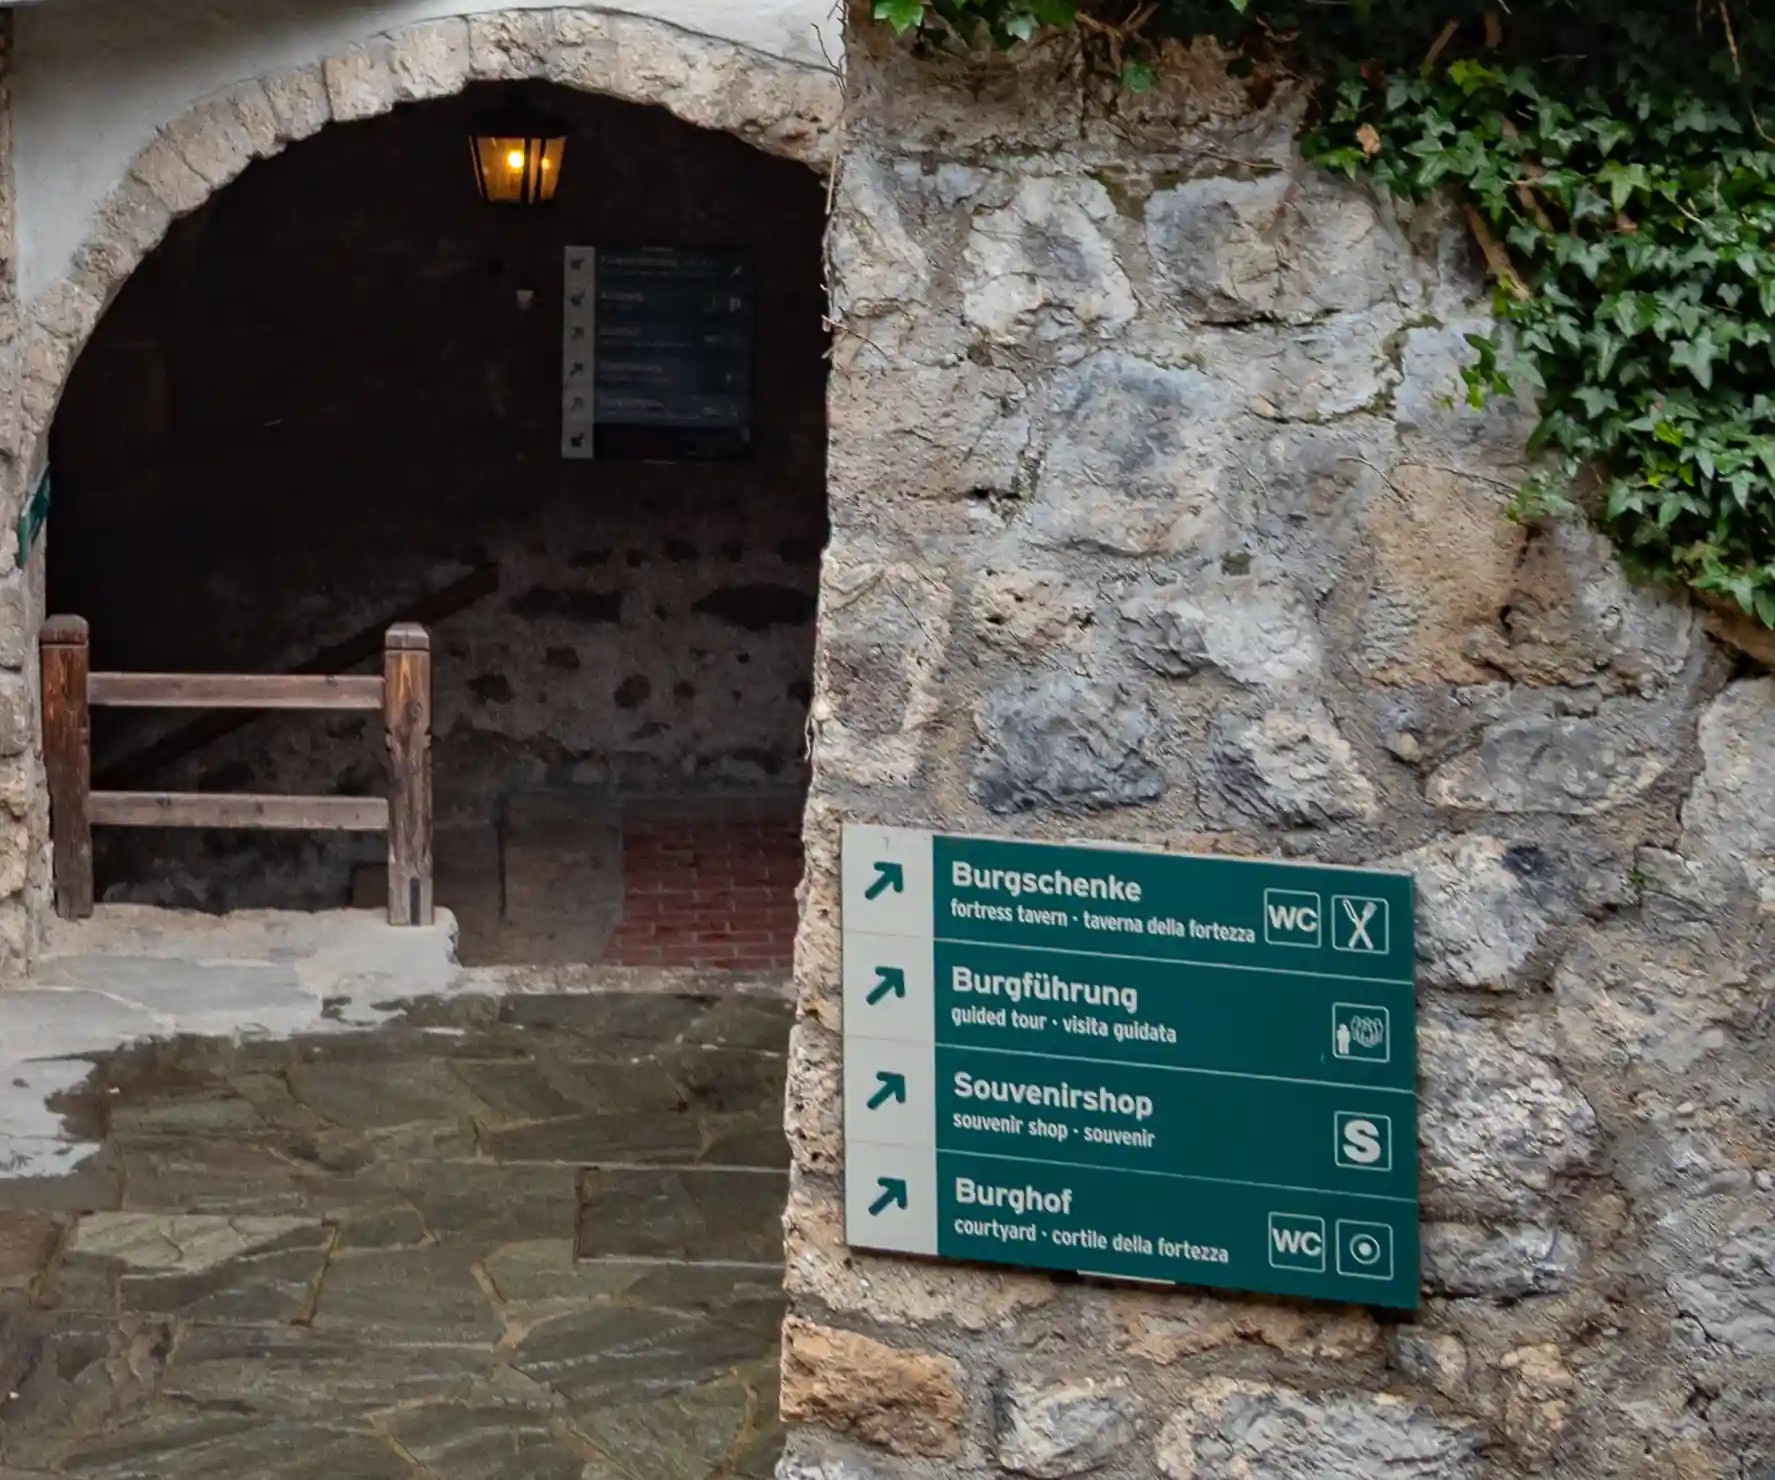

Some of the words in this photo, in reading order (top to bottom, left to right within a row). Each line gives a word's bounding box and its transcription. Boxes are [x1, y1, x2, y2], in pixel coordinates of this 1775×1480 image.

[952, 860, 1142, 902] Burgschenke
[950, 897, 1014, 923] fortress
[1017, 907, 1068, 927] tavern
[1083, 910, 1143, 934] taverna
[1146, 916, 1186, 937] della
[1188, 918, 1256, 944] fortezza
[1267, 904, 1319, 933] WC
[952, 966, 1139, 1014] Burgführung
[951, 1005, 1007, 1027] guided
[1011, 1009, 1048, 1031] tour
[1062, 1015, 1110, 1038] visita
[1112, 1021, 1178, 1044] guidata
[953, 1071, 1154, 1121] Souvenirshop
[952, 1111, 1024, 1135] souvenir
[1027, 1118, 1069, 1143] shop
[1083, 1125, 1156, 1149] souvenir
[1342, 1119, 1382, 1164] S
[955, 1177, 1073, 1215] Burghof
[954, 1216, 1037, 1242] courtyard
[1051, 1227, 1108, 1250] cortile
[1111, 1232, 1153, 1256] della
[1157, 1236, 1230, 1264] fortezza
[1271, 1227, 1323, 1257] WC
